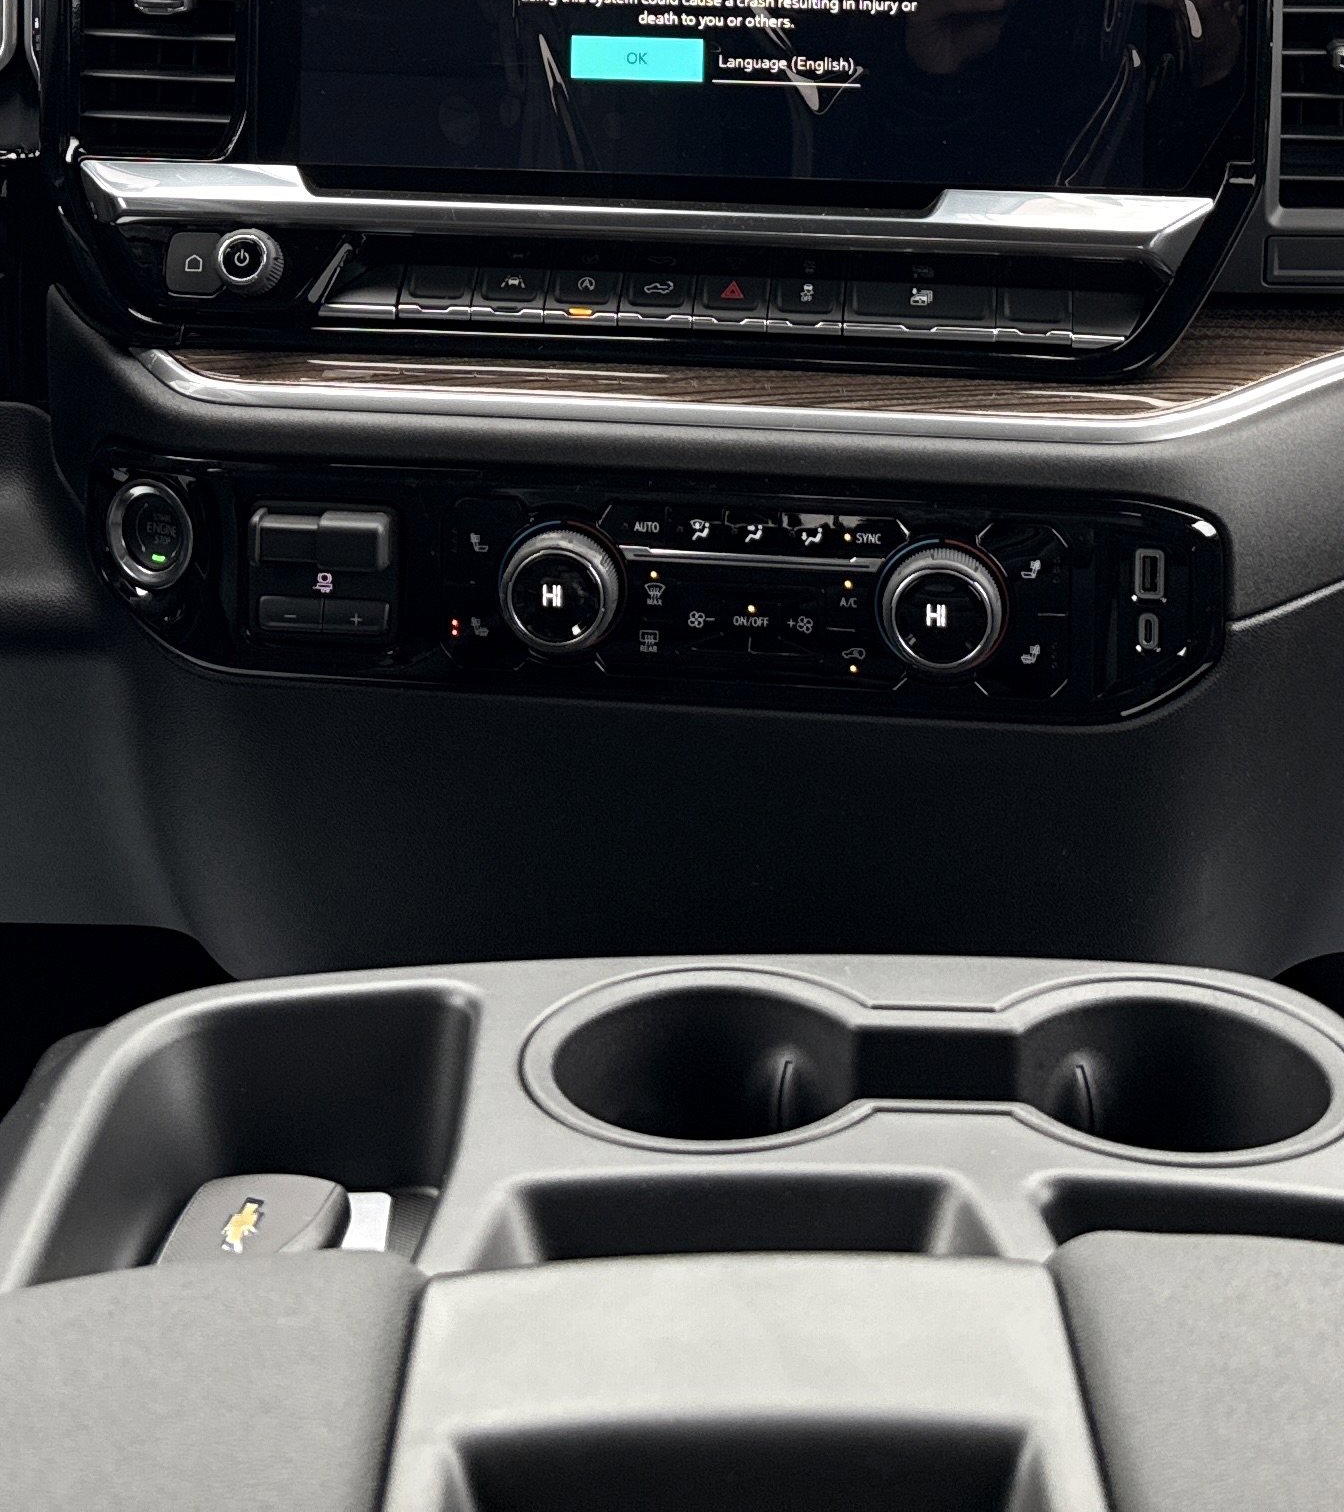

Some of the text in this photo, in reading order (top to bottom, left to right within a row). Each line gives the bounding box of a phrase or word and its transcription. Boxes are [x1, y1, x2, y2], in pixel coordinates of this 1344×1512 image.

[902, 2, 917, 11] or
[639, 10, 794, 29] death to you or others.
[626, 52, 648, 65] OK
[719, 55, 854, 74] Language (English)
[634, 522, 660, 533] AUTO
[856, 533, 882, 544] SYNC
[541, 584, 562, 607] HI
[840, 597, 857, 608] A/C
[733, 616, 769, 627] ON/OFF
[925, 604, 946, 627] HI
